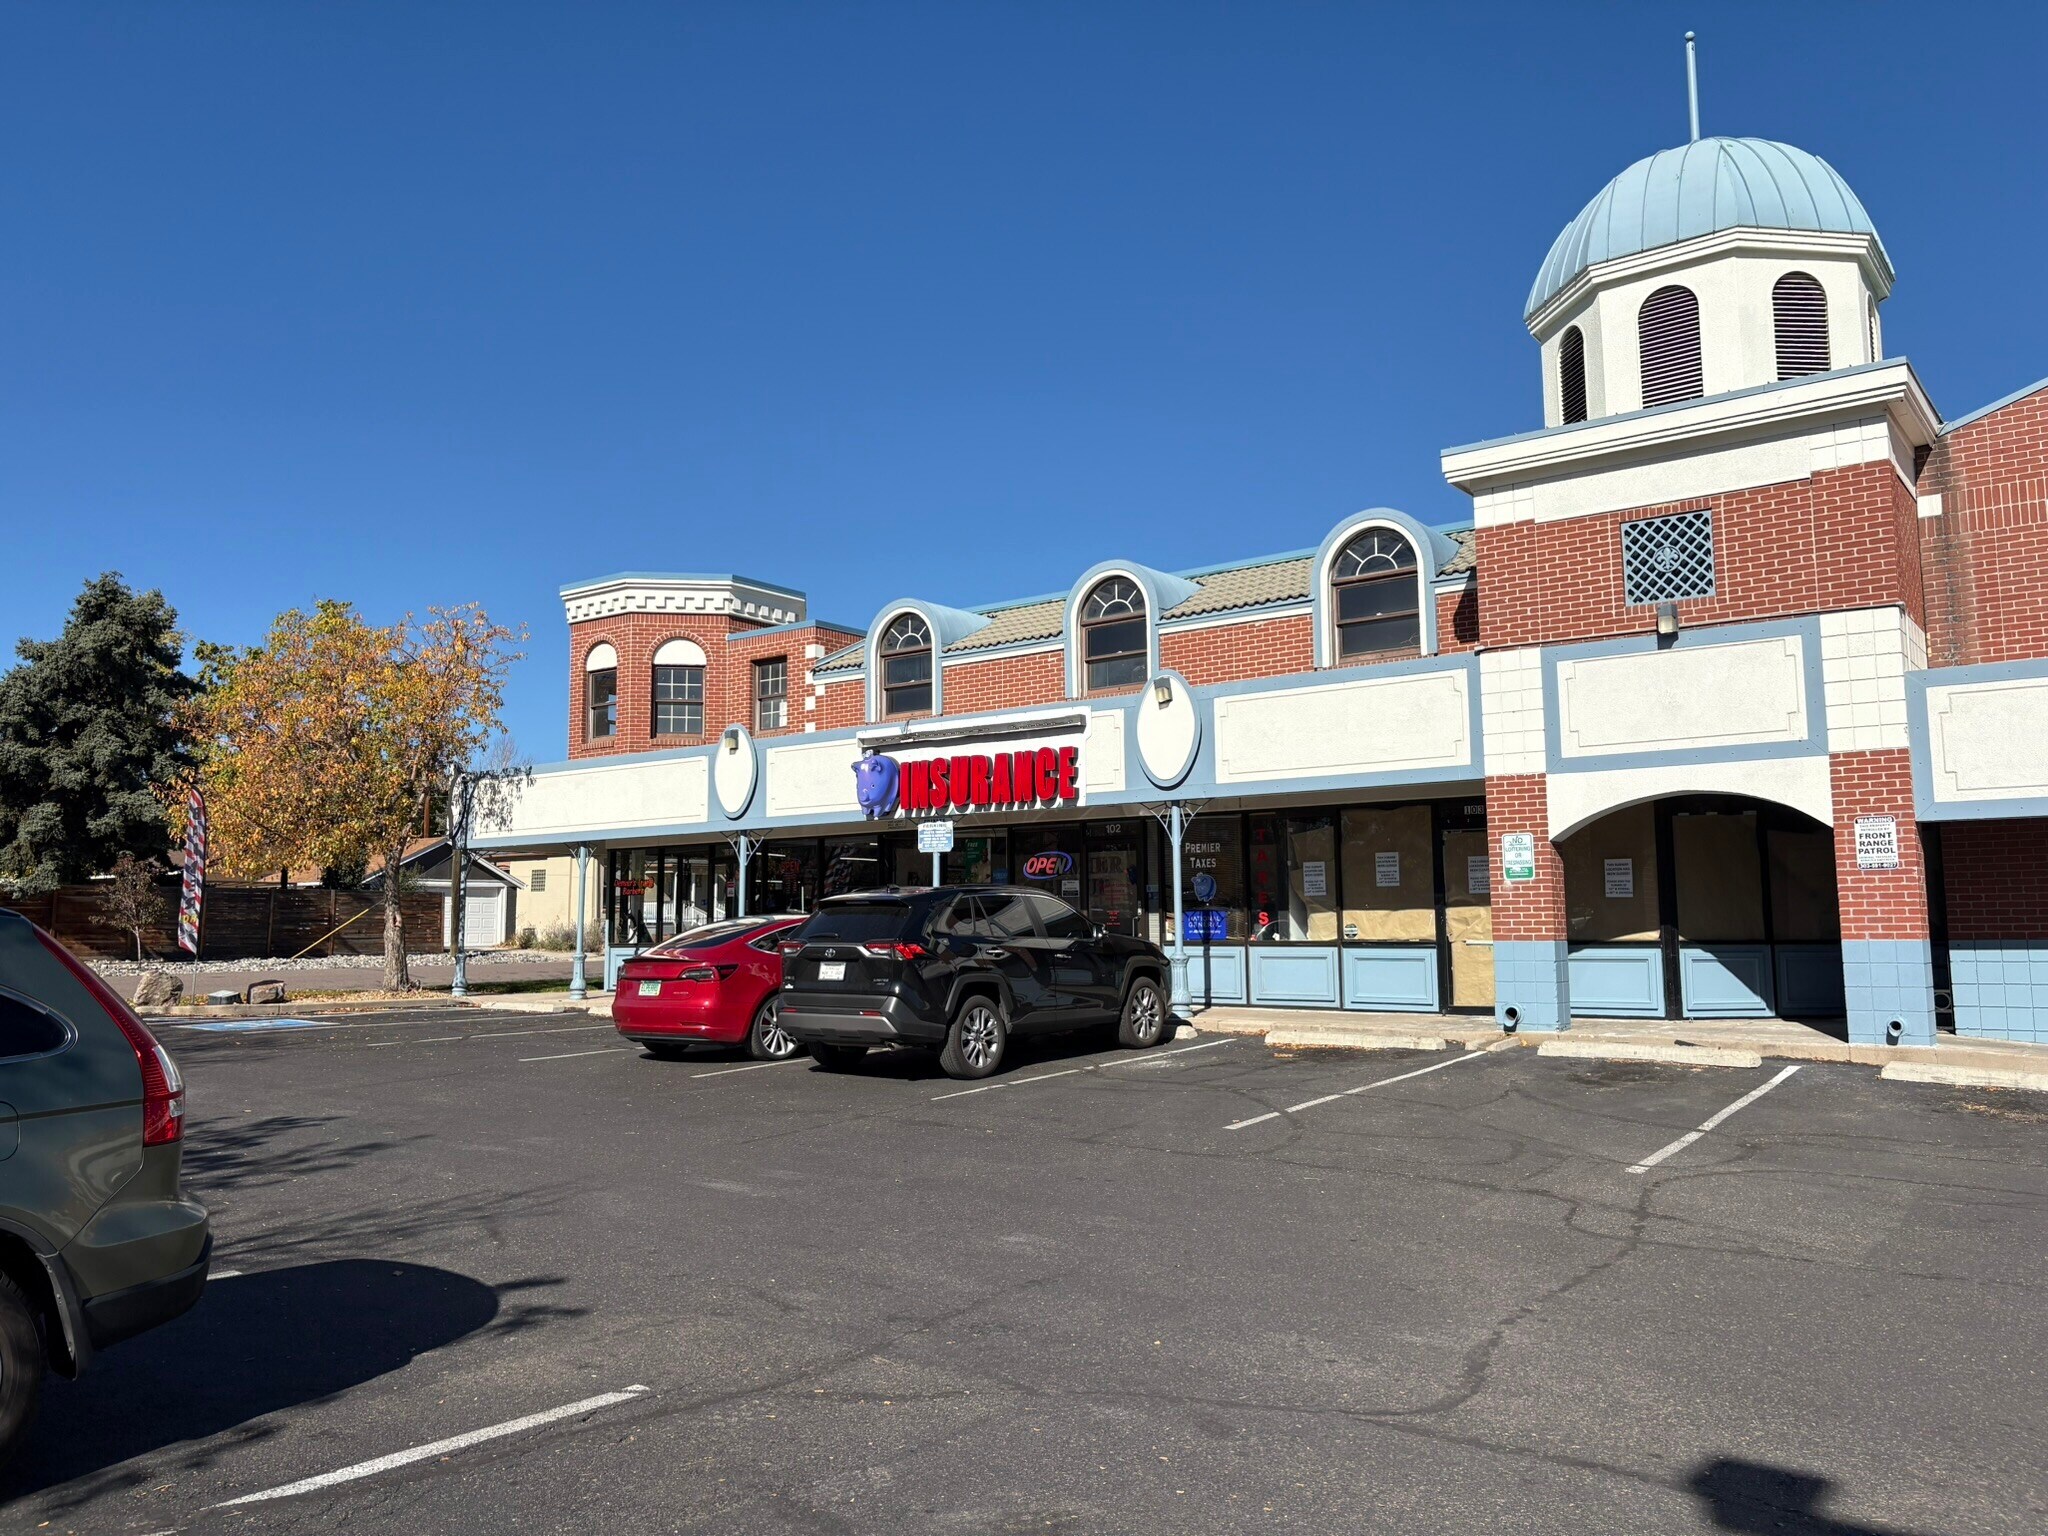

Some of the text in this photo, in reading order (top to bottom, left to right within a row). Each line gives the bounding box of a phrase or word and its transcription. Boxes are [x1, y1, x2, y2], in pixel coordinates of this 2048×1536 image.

[900, 746, 1077, 810] INSURANCE
[1464, 806, 1484, 815] 103
[1857, 816, 1891, 824] WARNING
[1105, 824, 1121, 834] 102
[1859, 839, 1894, 847] RANGE
[1185, 843, 1221, 854] PREMIER
[1858, 847, 1896, 855] PATROL
[1026, 857, 1066, 874] OPEN
[1190, 857, 1217, 869] TAXES
